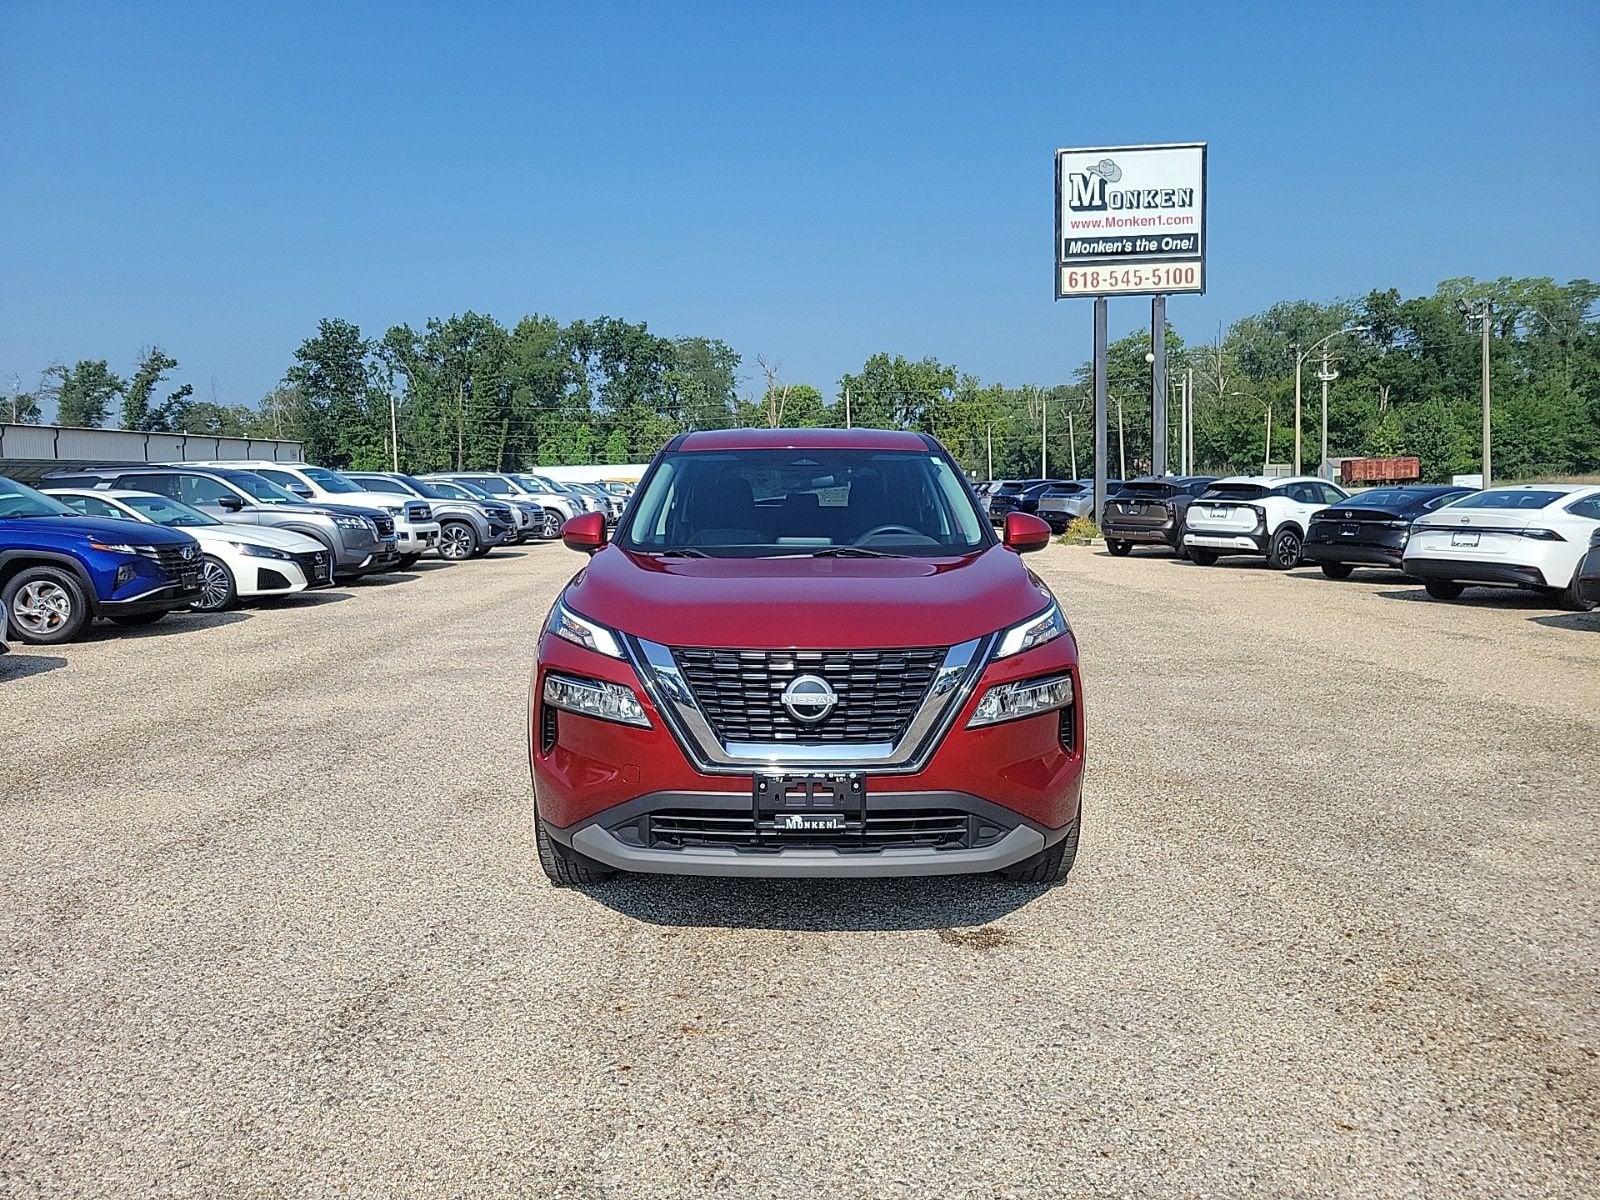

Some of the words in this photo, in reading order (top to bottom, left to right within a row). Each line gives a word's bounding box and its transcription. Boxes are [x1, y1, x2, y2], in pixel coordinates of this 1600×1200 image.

[1069, 173, 1193, 212] MONKEN
[1071, 215, 1193, 229] www.Monken1.com
[1069, 239, 1132, 254] Monken's
[1136, 237, 1158, 251] the
[1162, 236, 1193, 250] One!
[1069, 267, 1194, 288] 618-545-5100
[784, 695, 836, 704] NISSAN
